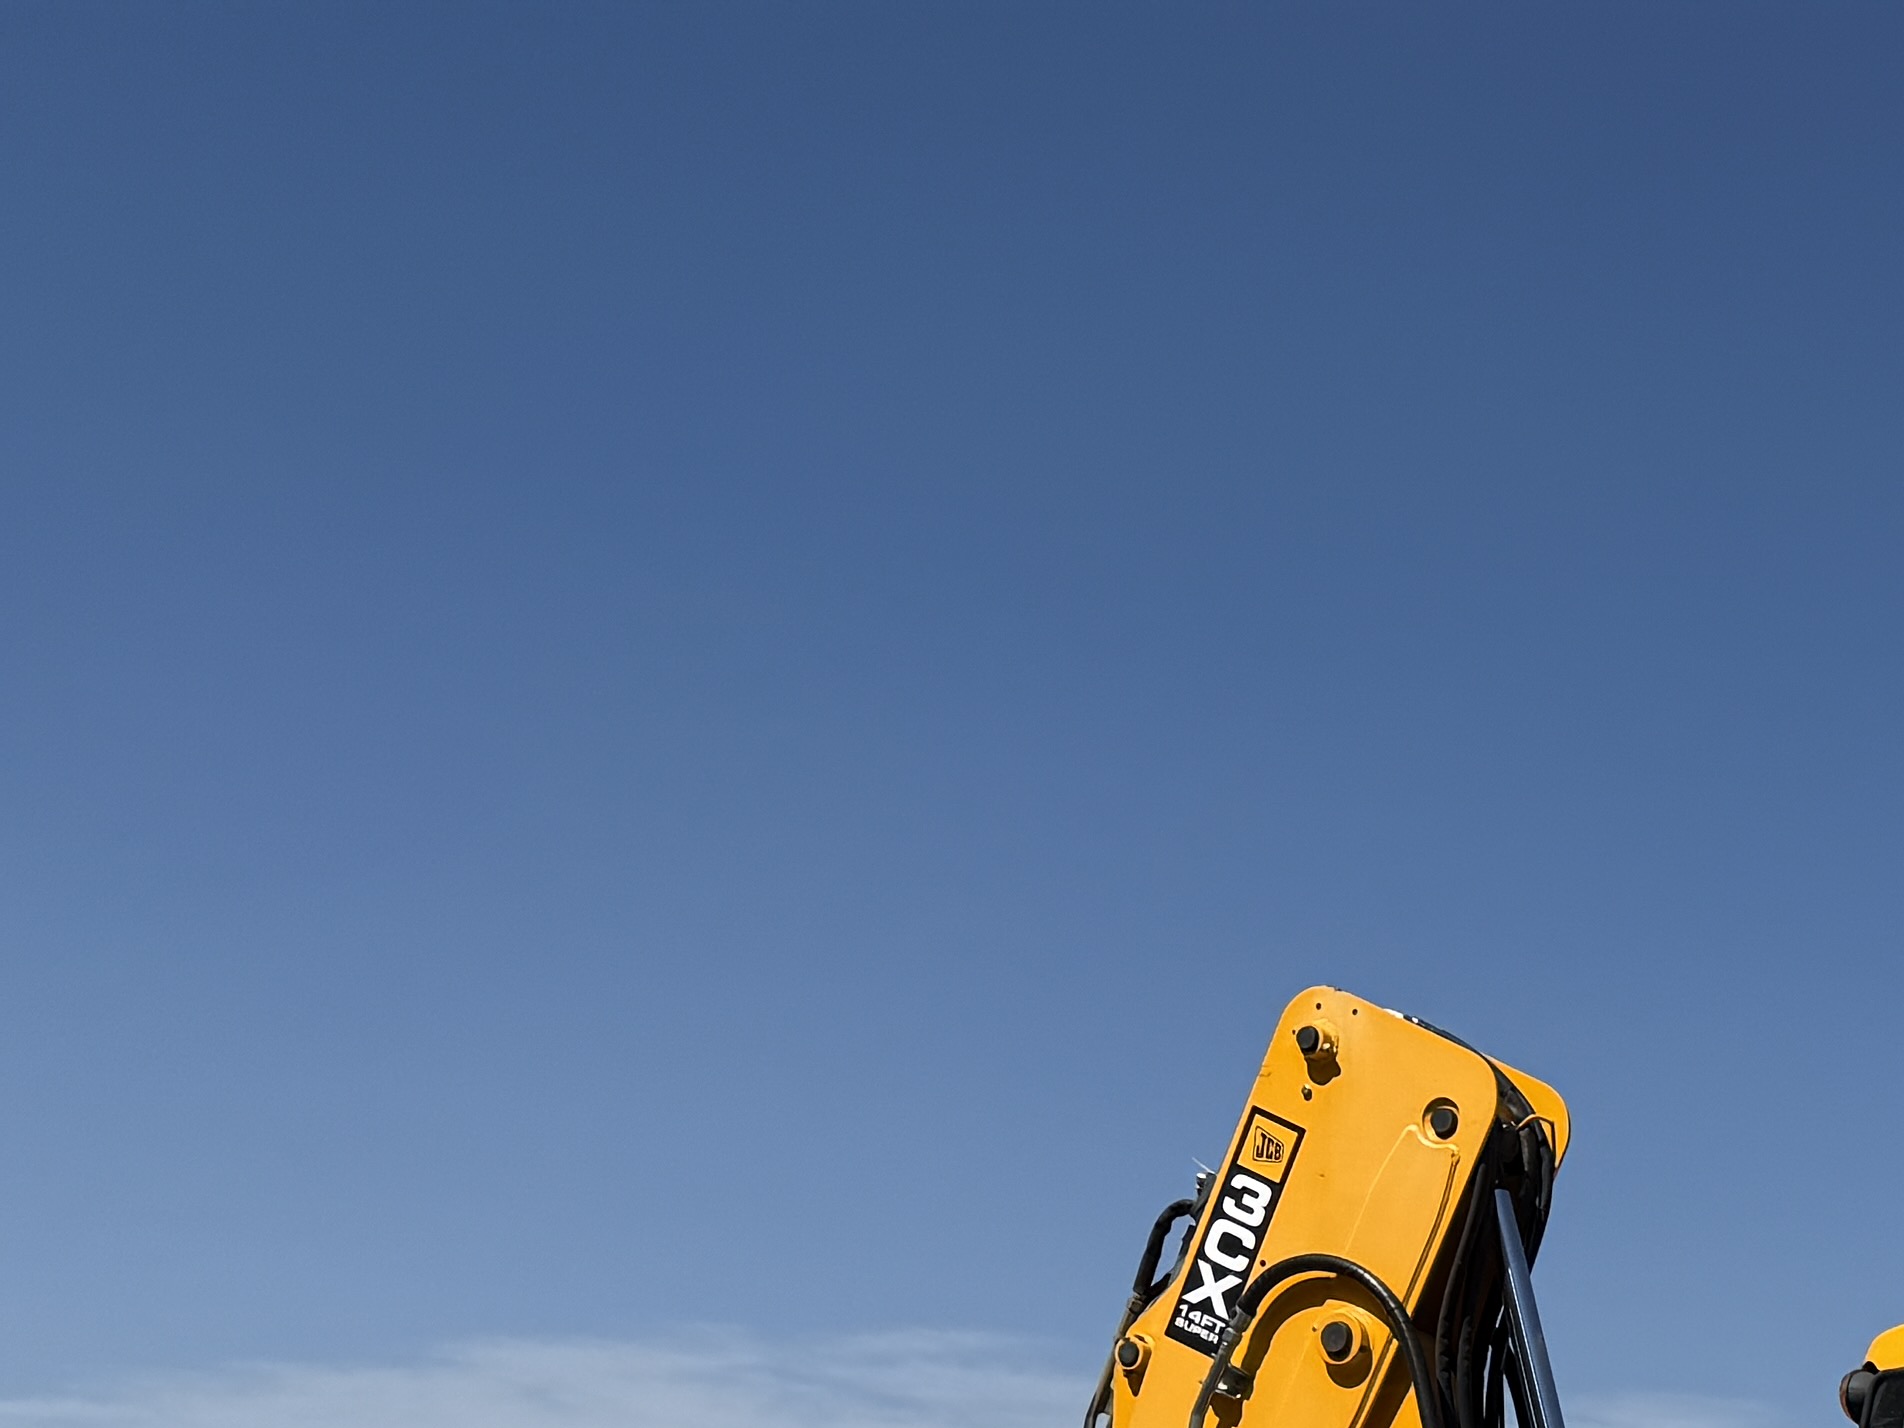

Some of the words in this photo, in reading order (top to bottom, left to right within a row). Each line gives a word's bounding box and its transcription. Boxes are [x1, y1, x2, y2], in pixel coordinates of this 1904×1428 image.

[1256, 1131, 1282, 1161] JCB
[1182, 1173, 1273, 1321] 3CX
[1174, 1316, 1219, 1345] SUPER
[1178, 1304, 1226, 1334] 14FT
